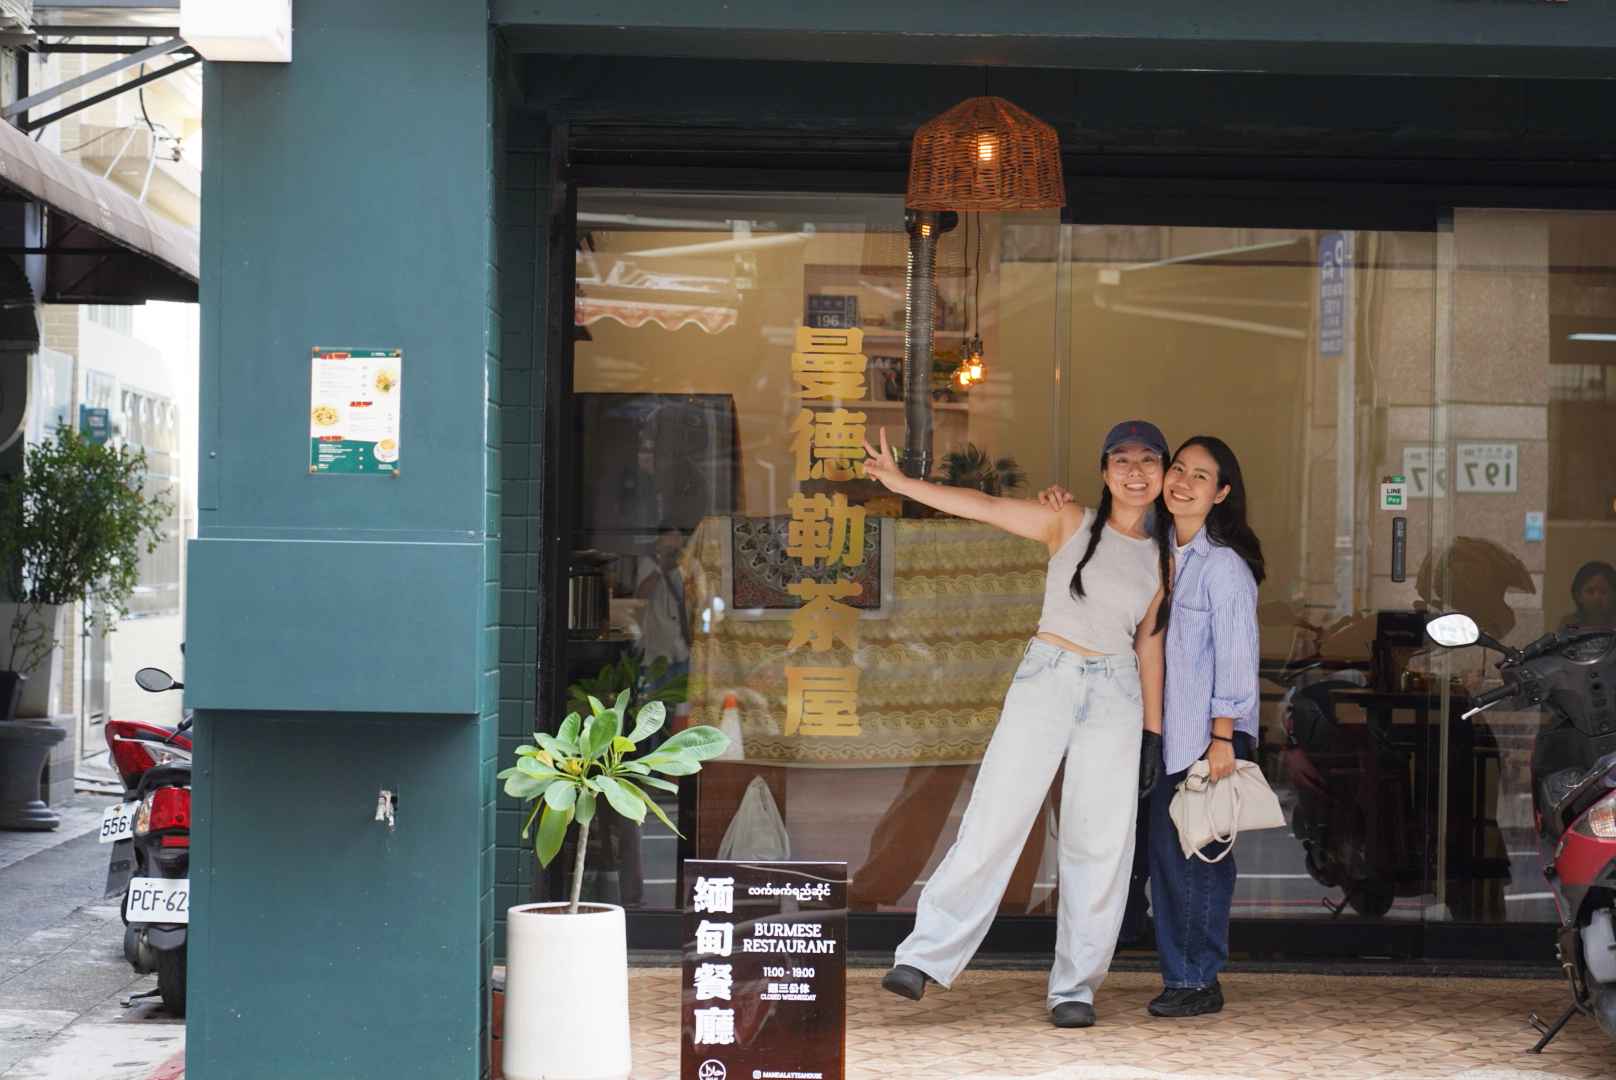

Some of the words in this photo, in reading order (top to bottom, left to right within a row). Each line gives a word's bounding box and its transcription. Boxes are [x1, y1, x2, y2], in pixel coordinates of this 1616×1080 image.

[1387, 496, 1401, 504] Pay
[784, 326, 868, 737] 曼德勒茶屋
[754, 923, 822, 938] BURMESE
[742, 939, 837, 954] RESTAURANT
[693, 876, 735, 1045] 緬甸餐廳
